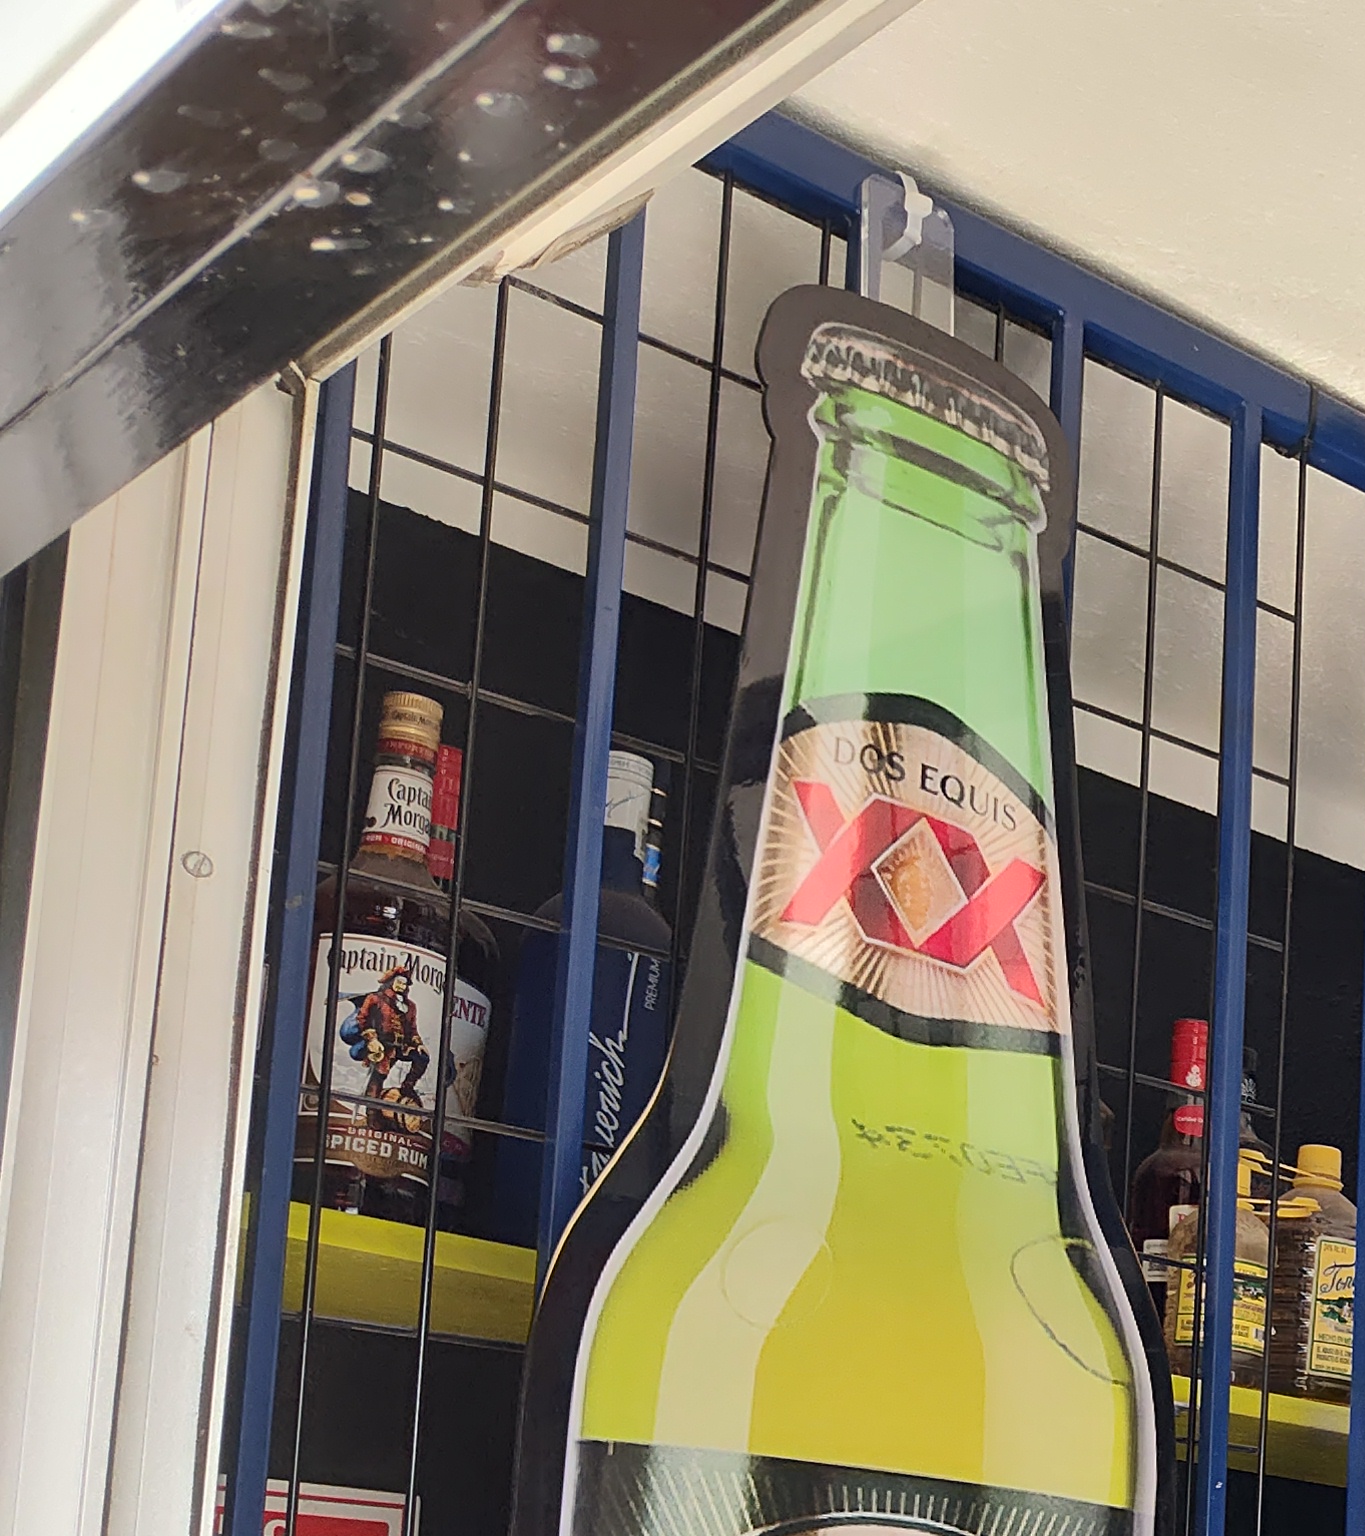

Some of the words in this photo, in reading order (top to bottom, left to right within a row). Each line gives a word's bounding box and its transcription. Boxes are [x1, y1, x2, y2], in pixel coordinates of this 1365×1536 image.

[387, 776, 433, 812] Captai
[833, 736, 906, 781] DOS
[919, 763, 1019, 832] EQUIS
[381, 803, 431, 836] Morga
[399, 1147, 429, 1170] RUM
